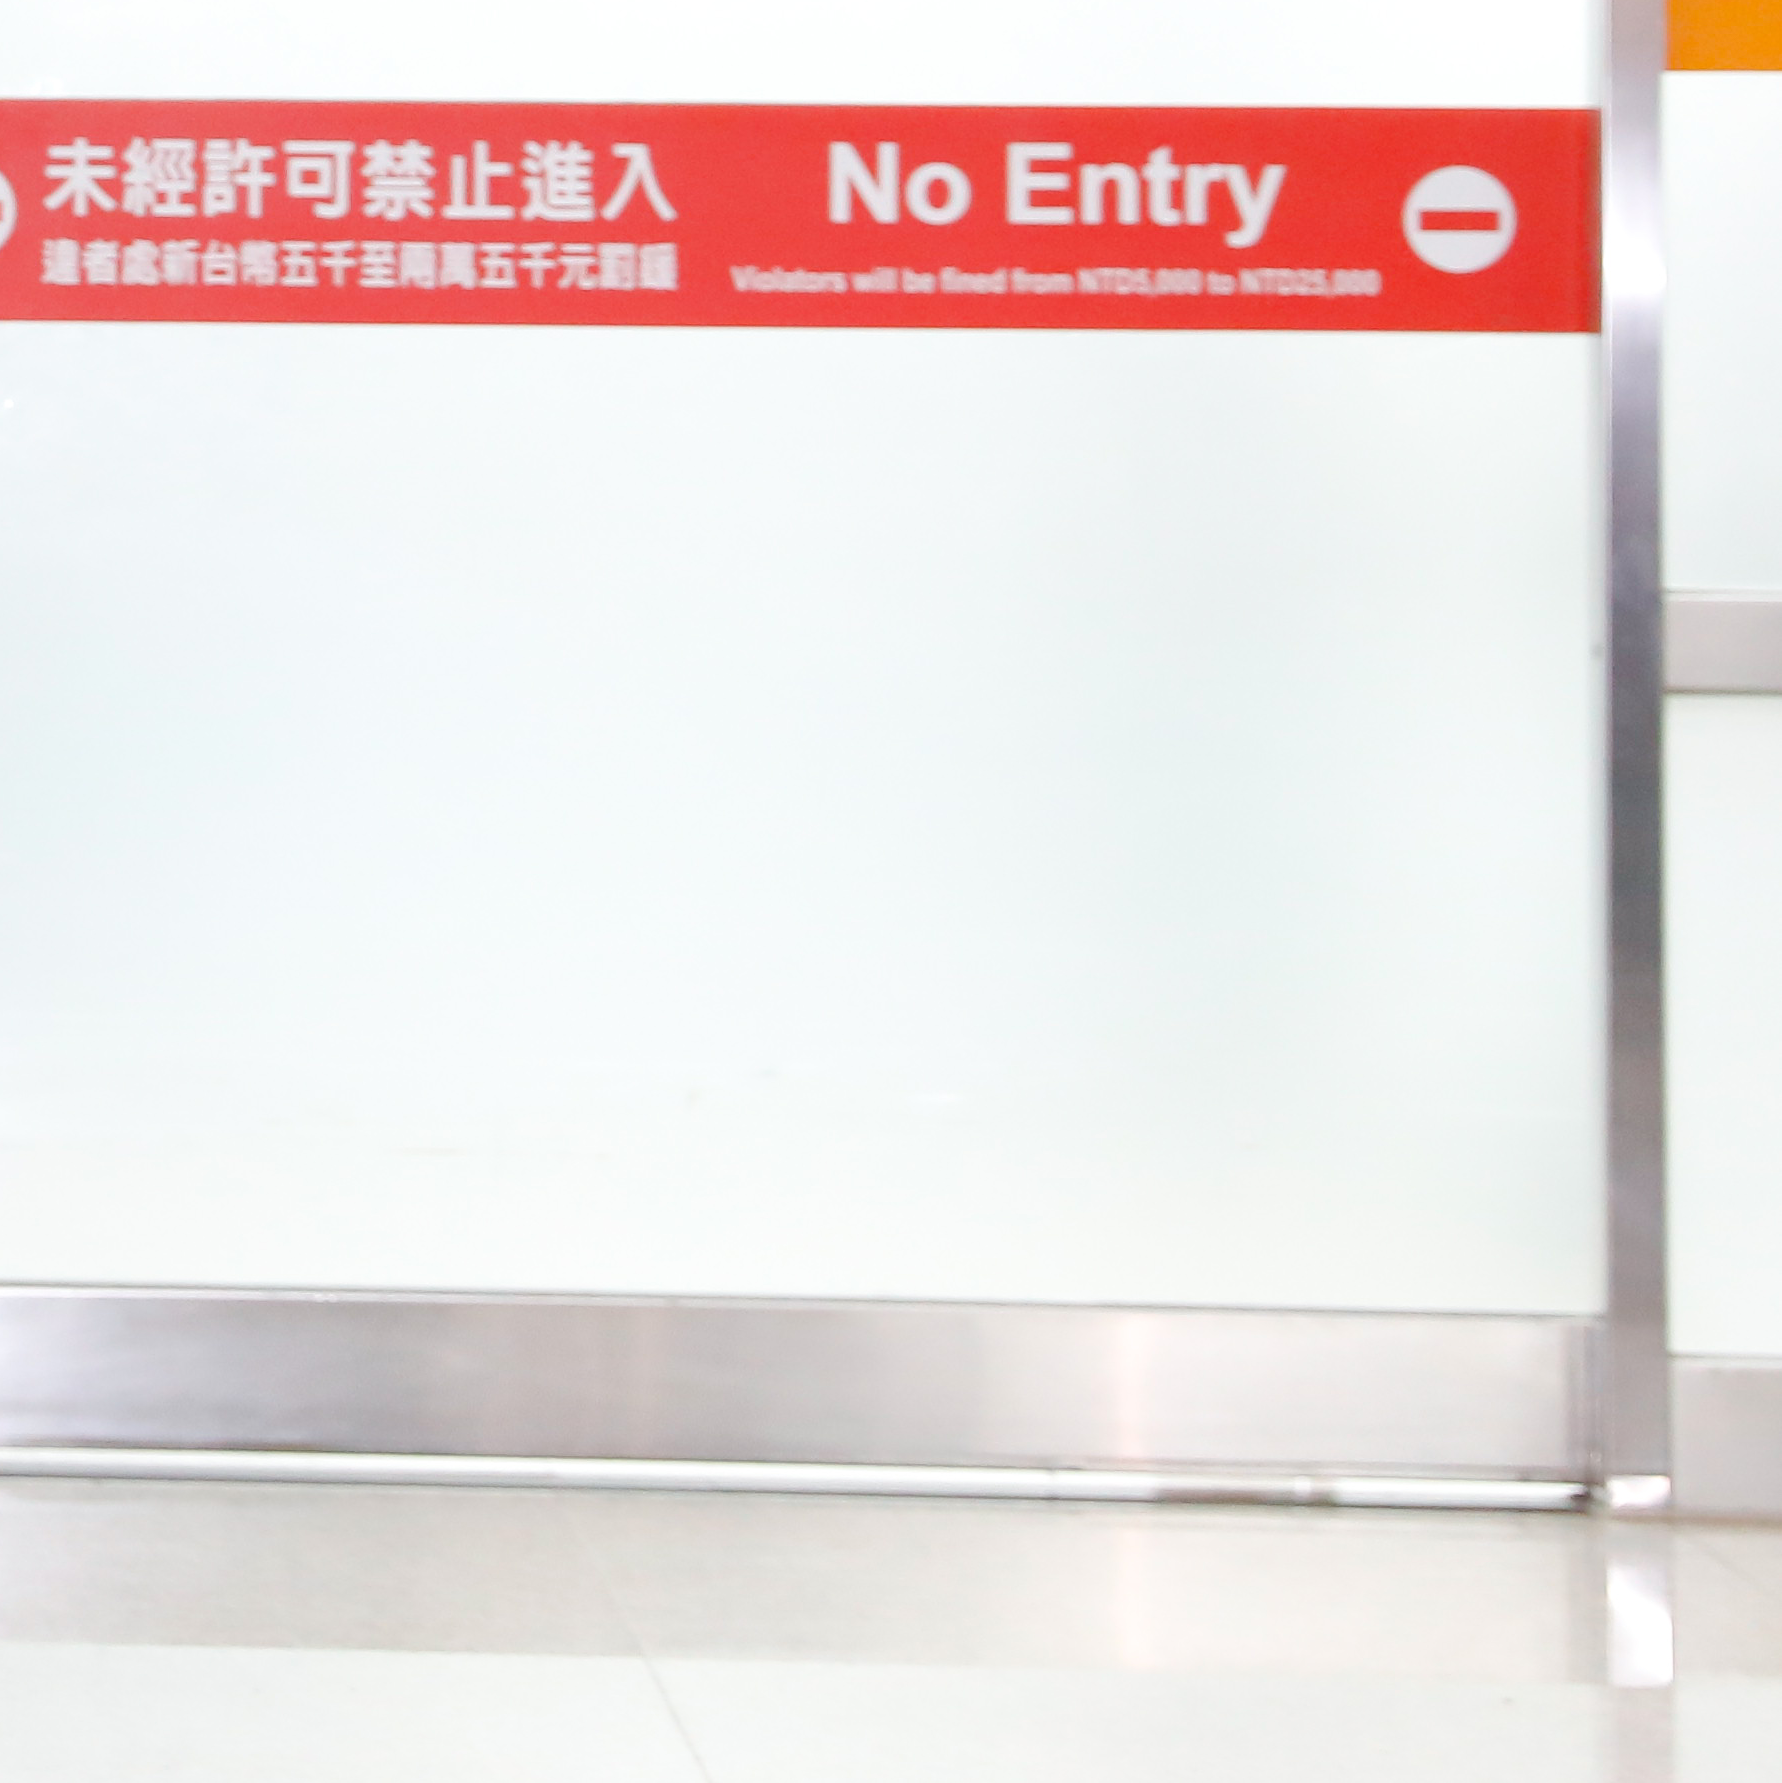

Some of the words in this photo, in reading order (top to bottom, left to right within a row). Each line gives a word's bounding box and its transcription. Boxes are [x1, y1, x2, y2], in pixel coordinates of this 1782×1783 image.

[43, 137, 677, 222] 未經許可禁止進入
[829, 142, 971, 225] No
[1007, 142, 1286, 248] Entry
